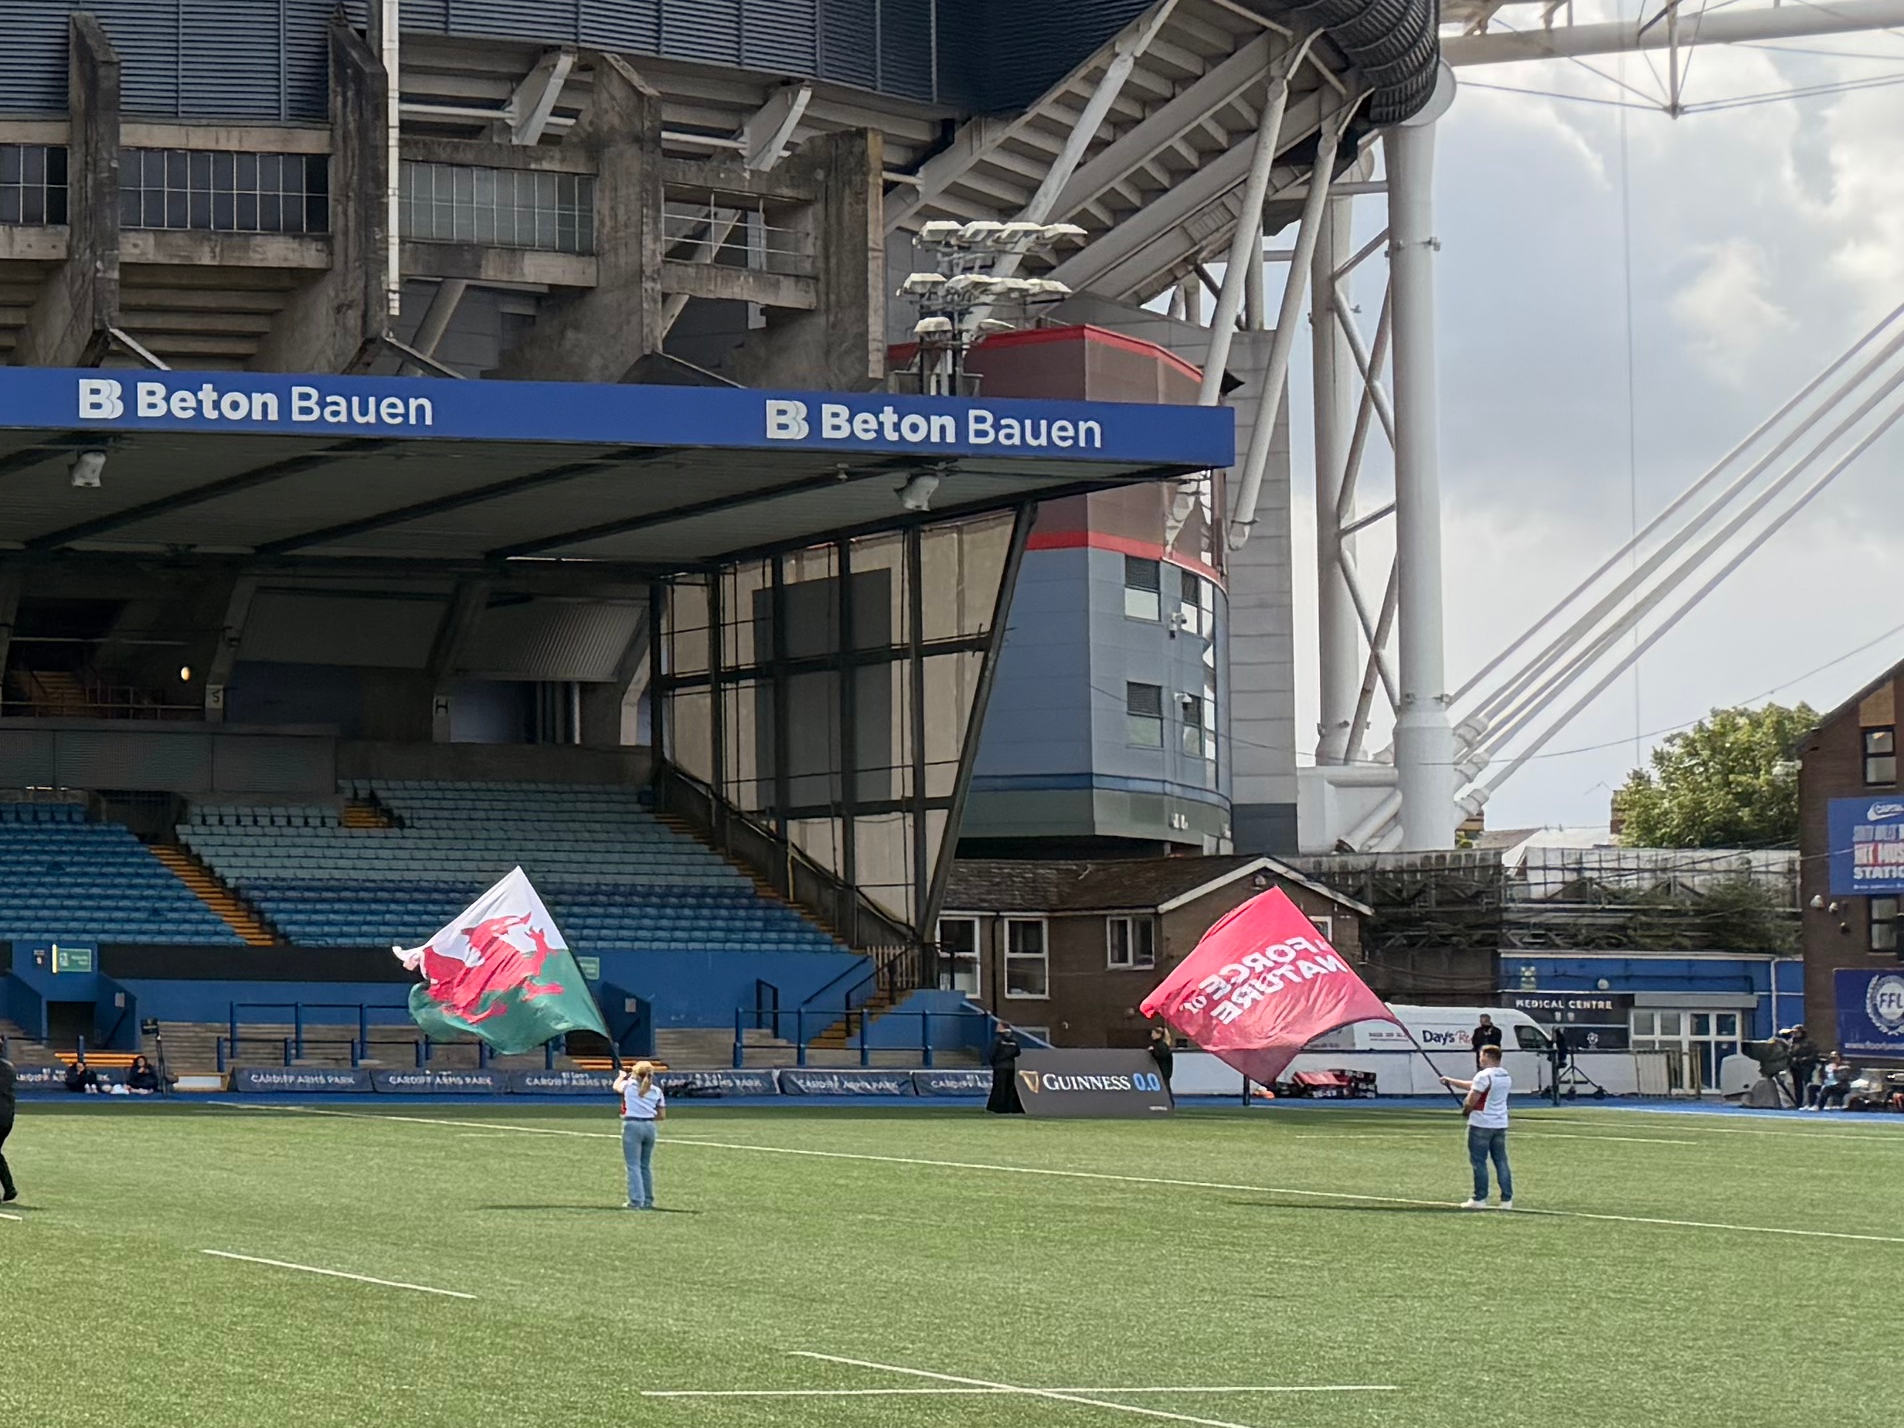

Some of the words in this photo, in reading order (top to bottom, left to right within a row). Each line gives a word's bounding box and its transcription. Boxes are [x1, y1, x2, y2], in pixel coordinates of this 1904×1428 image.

[136, 381, 279, 421] Beton
[291, 386, 433, 425] Bauen
[821, 403, 956, 444] Beton
[968, 409, 1103, 448] Bauen
[1515, 999, 1565, 1010] MEDICAL
[1568, 1000, 1613, 1010] CENTRE
[1042, 1073, 1131, 1091] GUINNESS
[1133, 1072, 1161, 1092] 0.0
